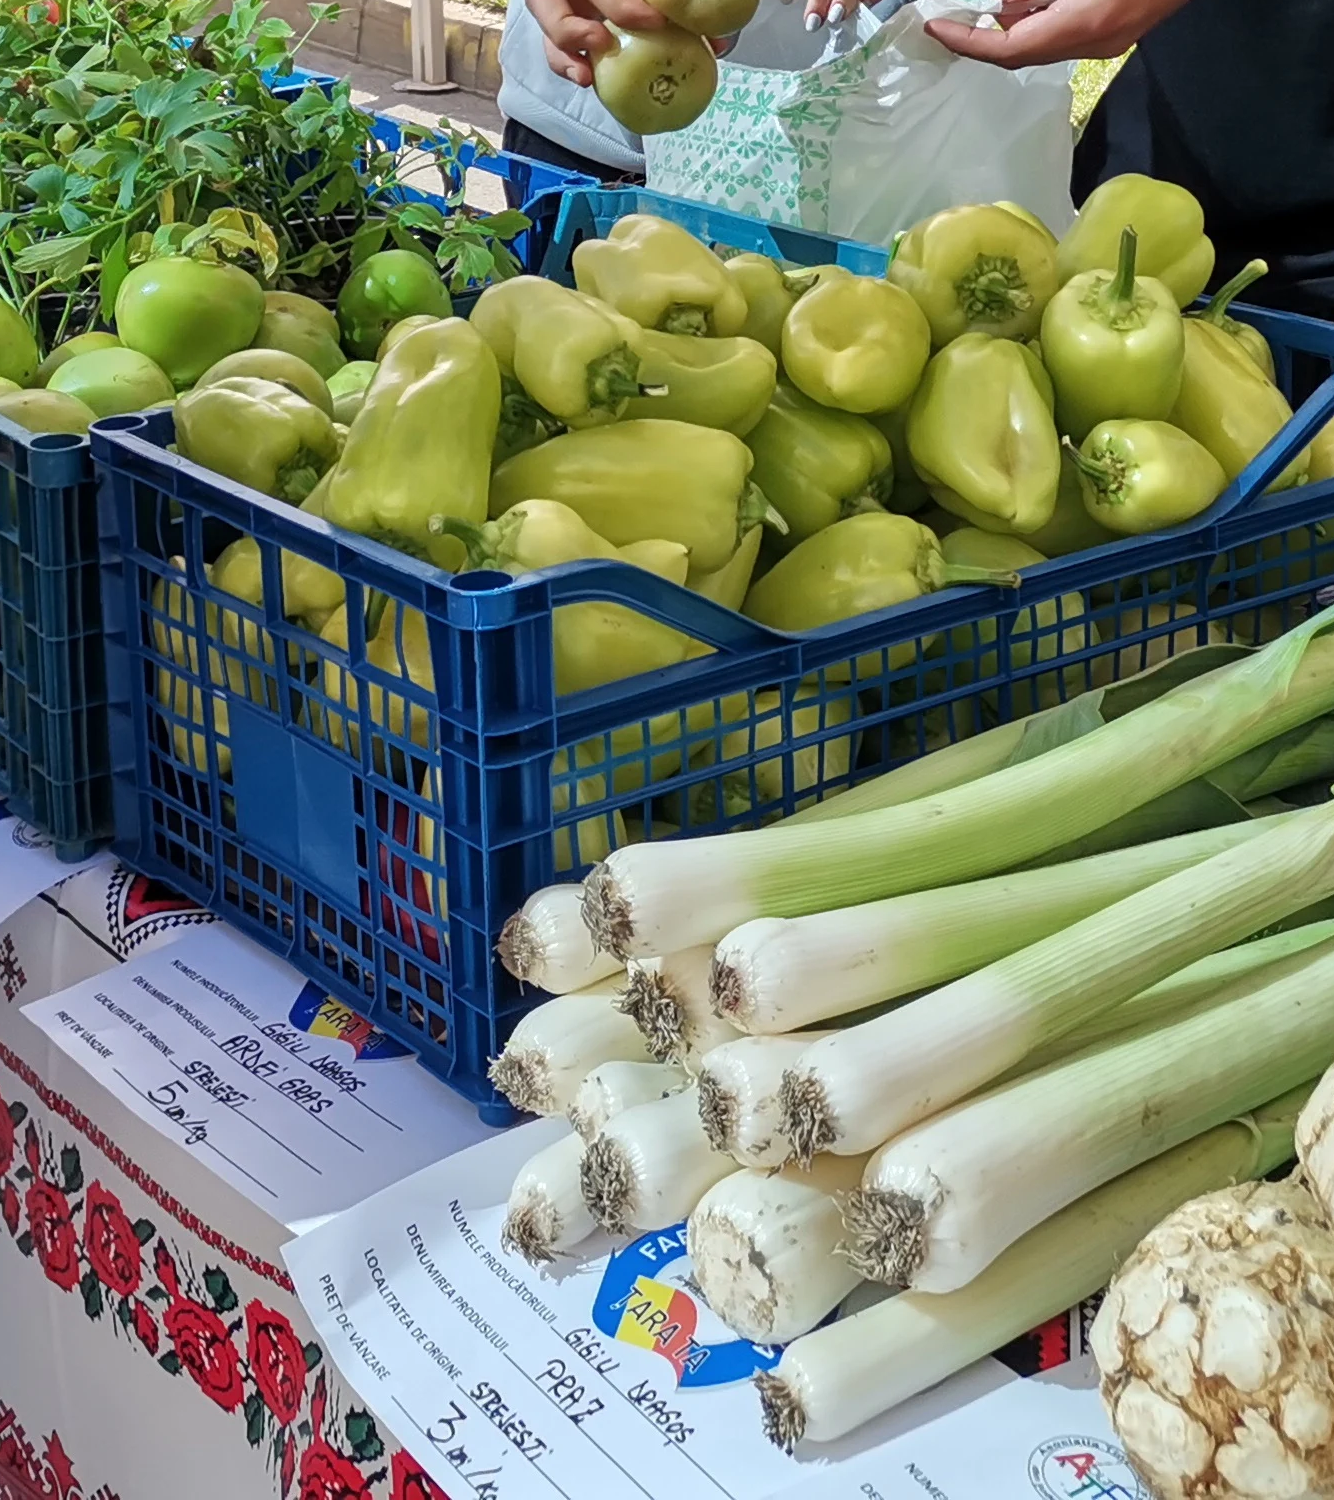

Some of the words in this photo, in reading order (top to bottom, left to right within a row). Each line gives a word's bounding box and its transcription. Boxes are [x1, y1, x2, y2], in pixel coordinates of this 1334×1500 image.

[147, 1078, 190, 1106] 5
[277, 1077, 335, 1116] GRAS
[447, 1198, 486, 1255] NUMELE
[363, 1247, 415, 1332] LOCALITATEA
[410, 1326, 424, 1345] DE
[422, 1340, 464, 1382] ORIGINE
[405, 1223, 457, 1300] DENUMIREA
[451, 1295, 510, 1354] PRODUSULUI
[534, 1358, 606, 1426] PRAZ
[335, 1312, 354, 1332] DE
[349, 1330, 392, 1382] VÂNZARE
[425, 1399, 468, 1444] 3
[672, 1335, 712, 1375] TA
